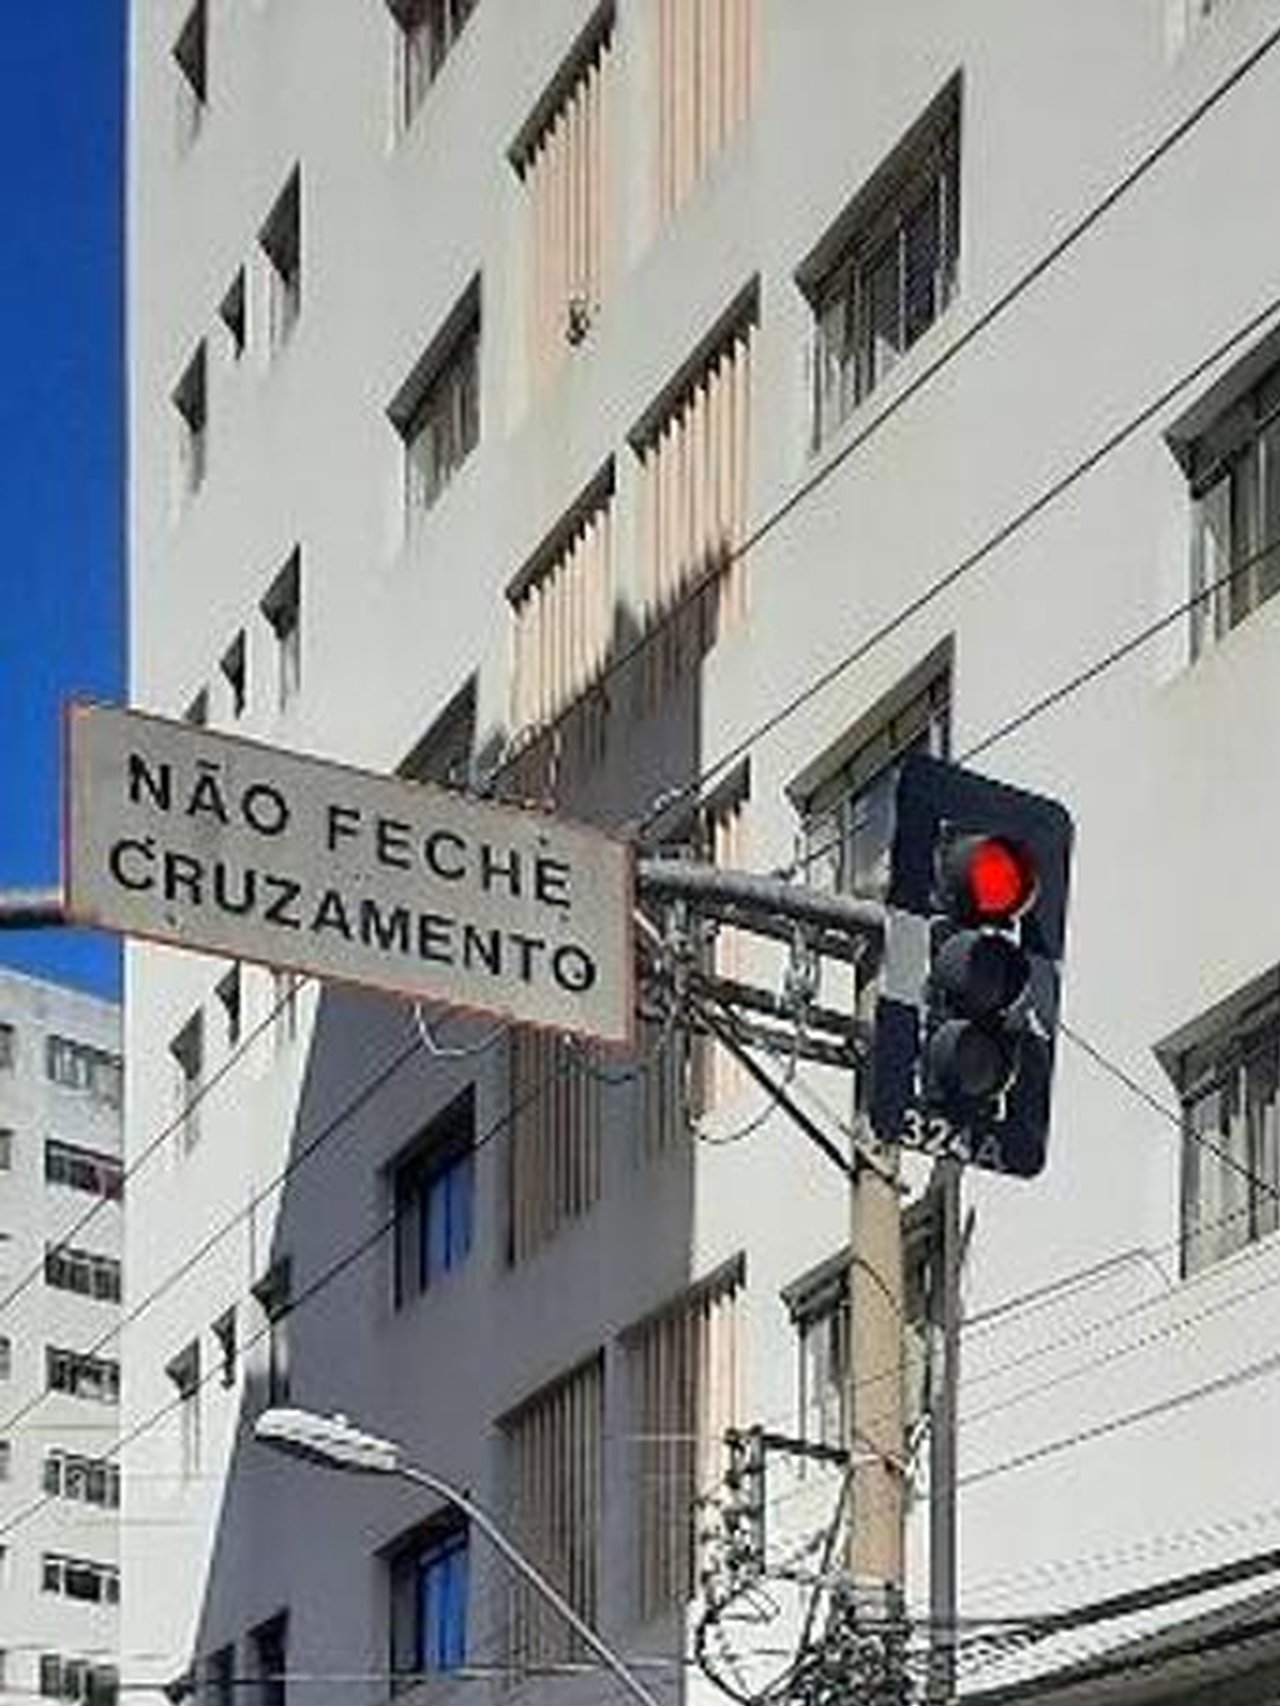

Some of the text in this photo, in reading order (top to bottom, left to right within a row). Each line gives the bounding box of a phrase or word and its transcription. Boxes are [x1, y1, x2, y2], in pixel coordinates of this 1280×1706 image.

[128, 754, 571, 908] NÃO FECHE
[108, 839, 597, 992] CRUZAMENTO
